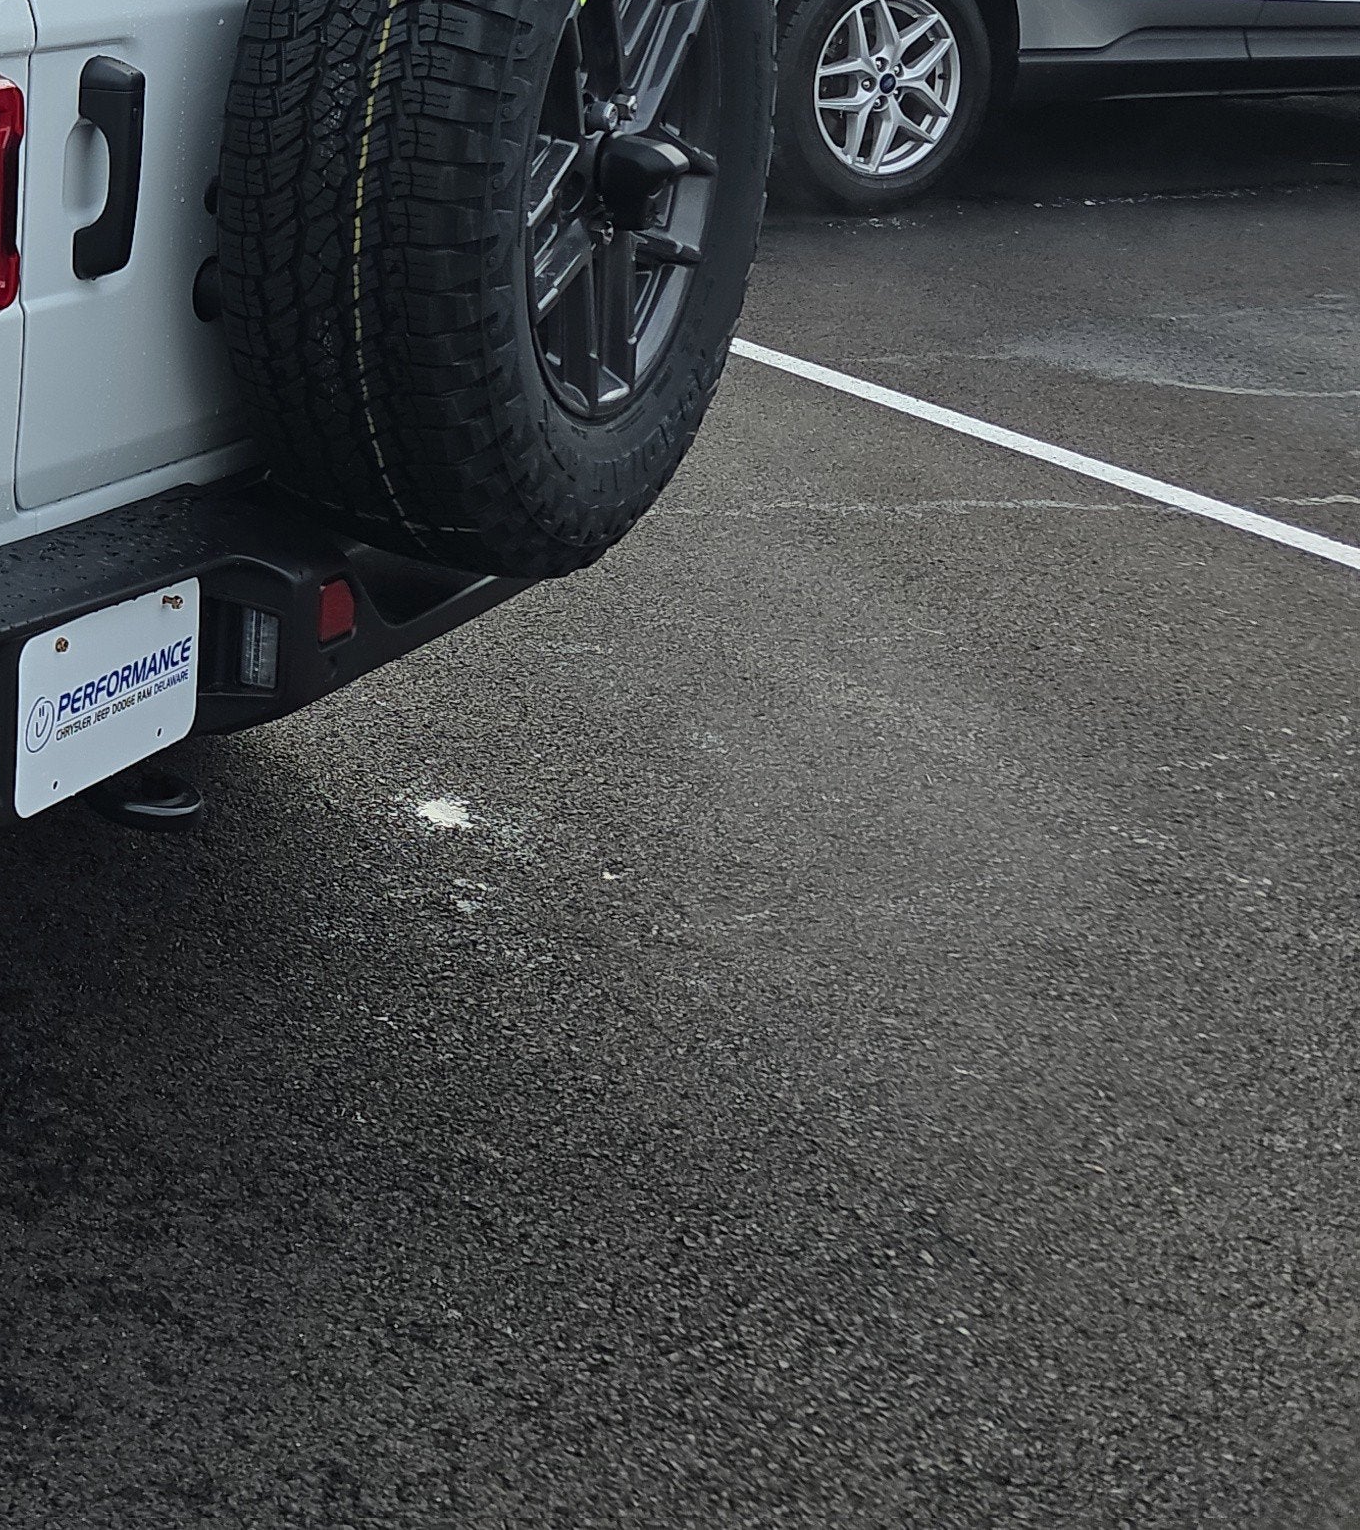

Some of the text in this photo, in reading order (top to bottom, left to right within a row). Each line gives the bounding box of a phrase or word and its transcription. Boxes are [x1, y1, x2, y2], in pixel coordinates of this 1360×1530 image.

[56, 669, 189, 741] CHRYSLER JEEP DODGE RAM DELAWARE
[57, 636, 192, 721] PERFORMANCE
